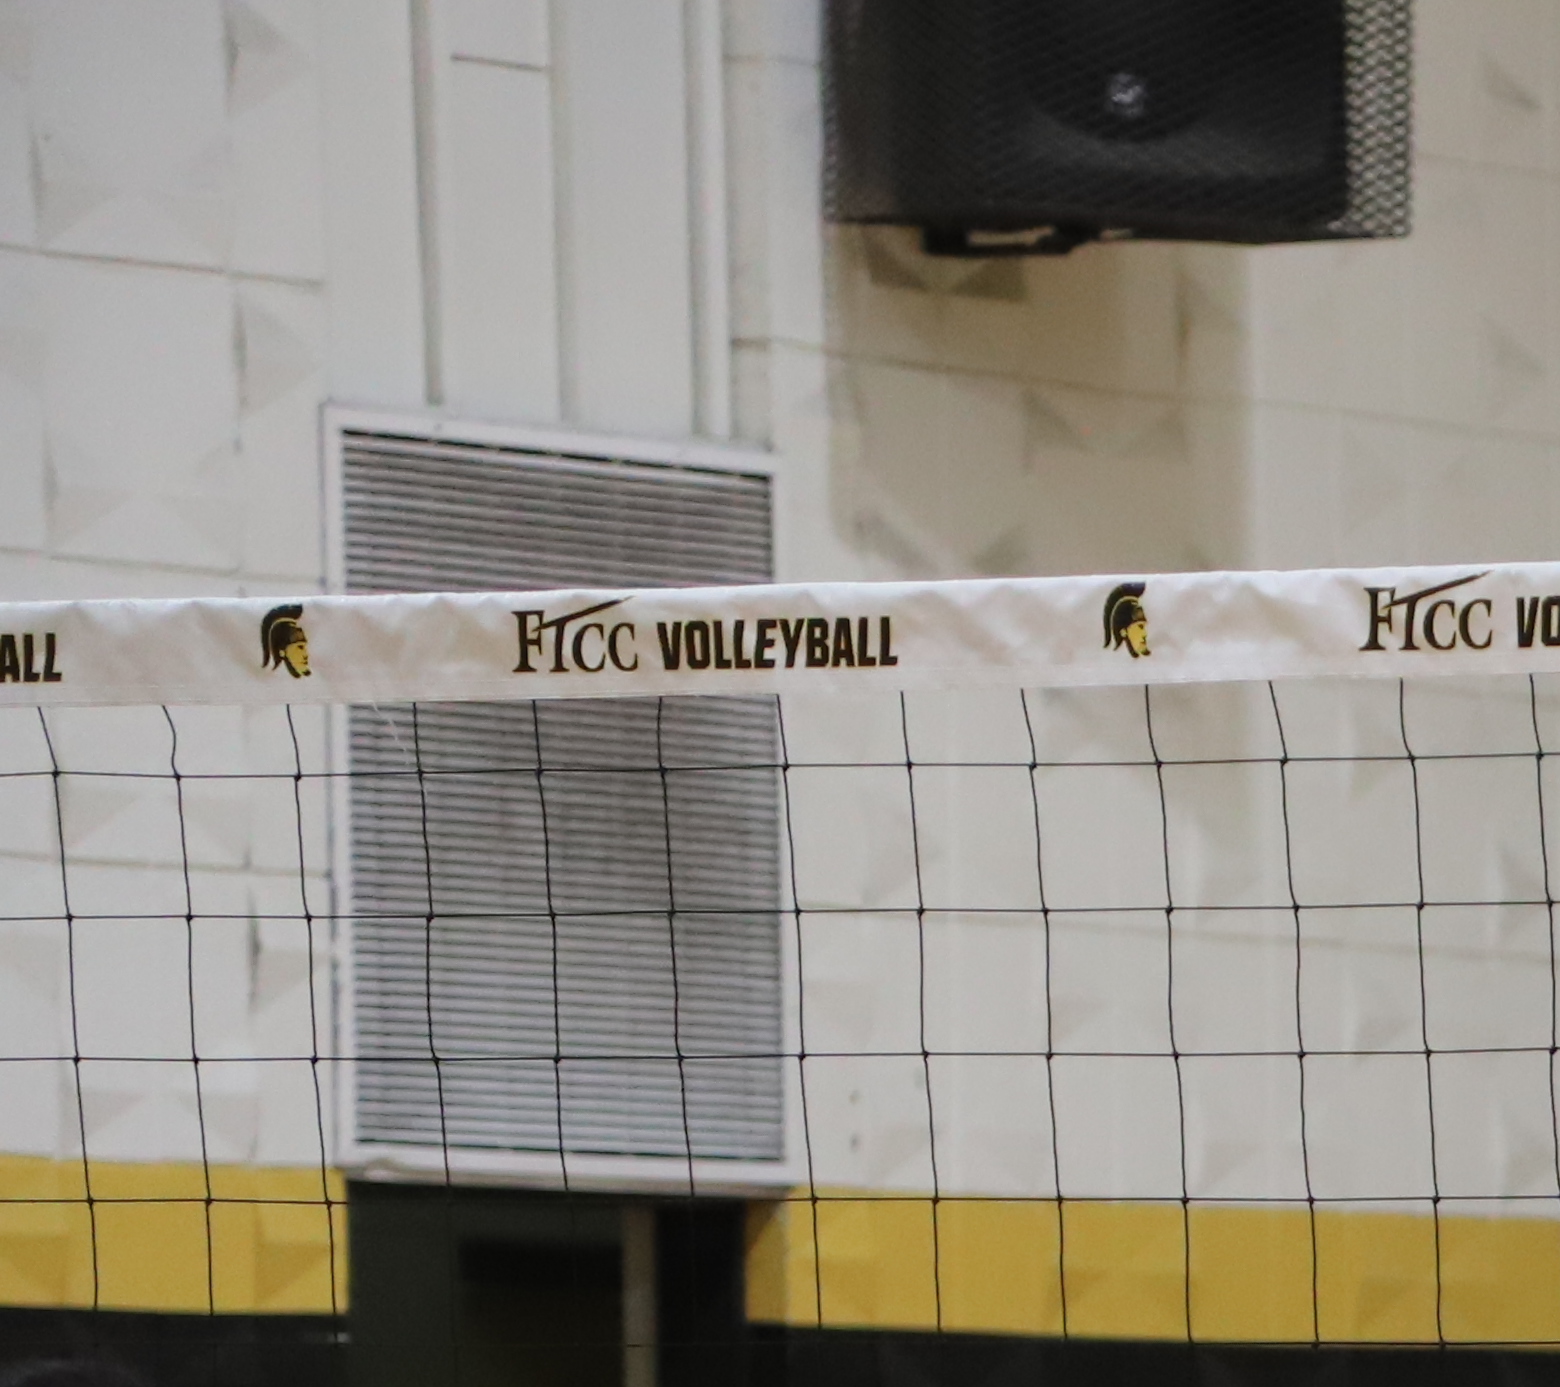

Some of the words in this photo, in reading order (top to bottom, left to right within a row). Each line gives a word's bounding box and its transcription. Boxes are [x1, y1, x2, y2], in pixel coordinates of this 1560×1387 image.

[511, 596, 639, 674] FTCC
[656, 616, 898, 671] VOLLEYBALL
[1359, 570, 1493, 652] FTCC
